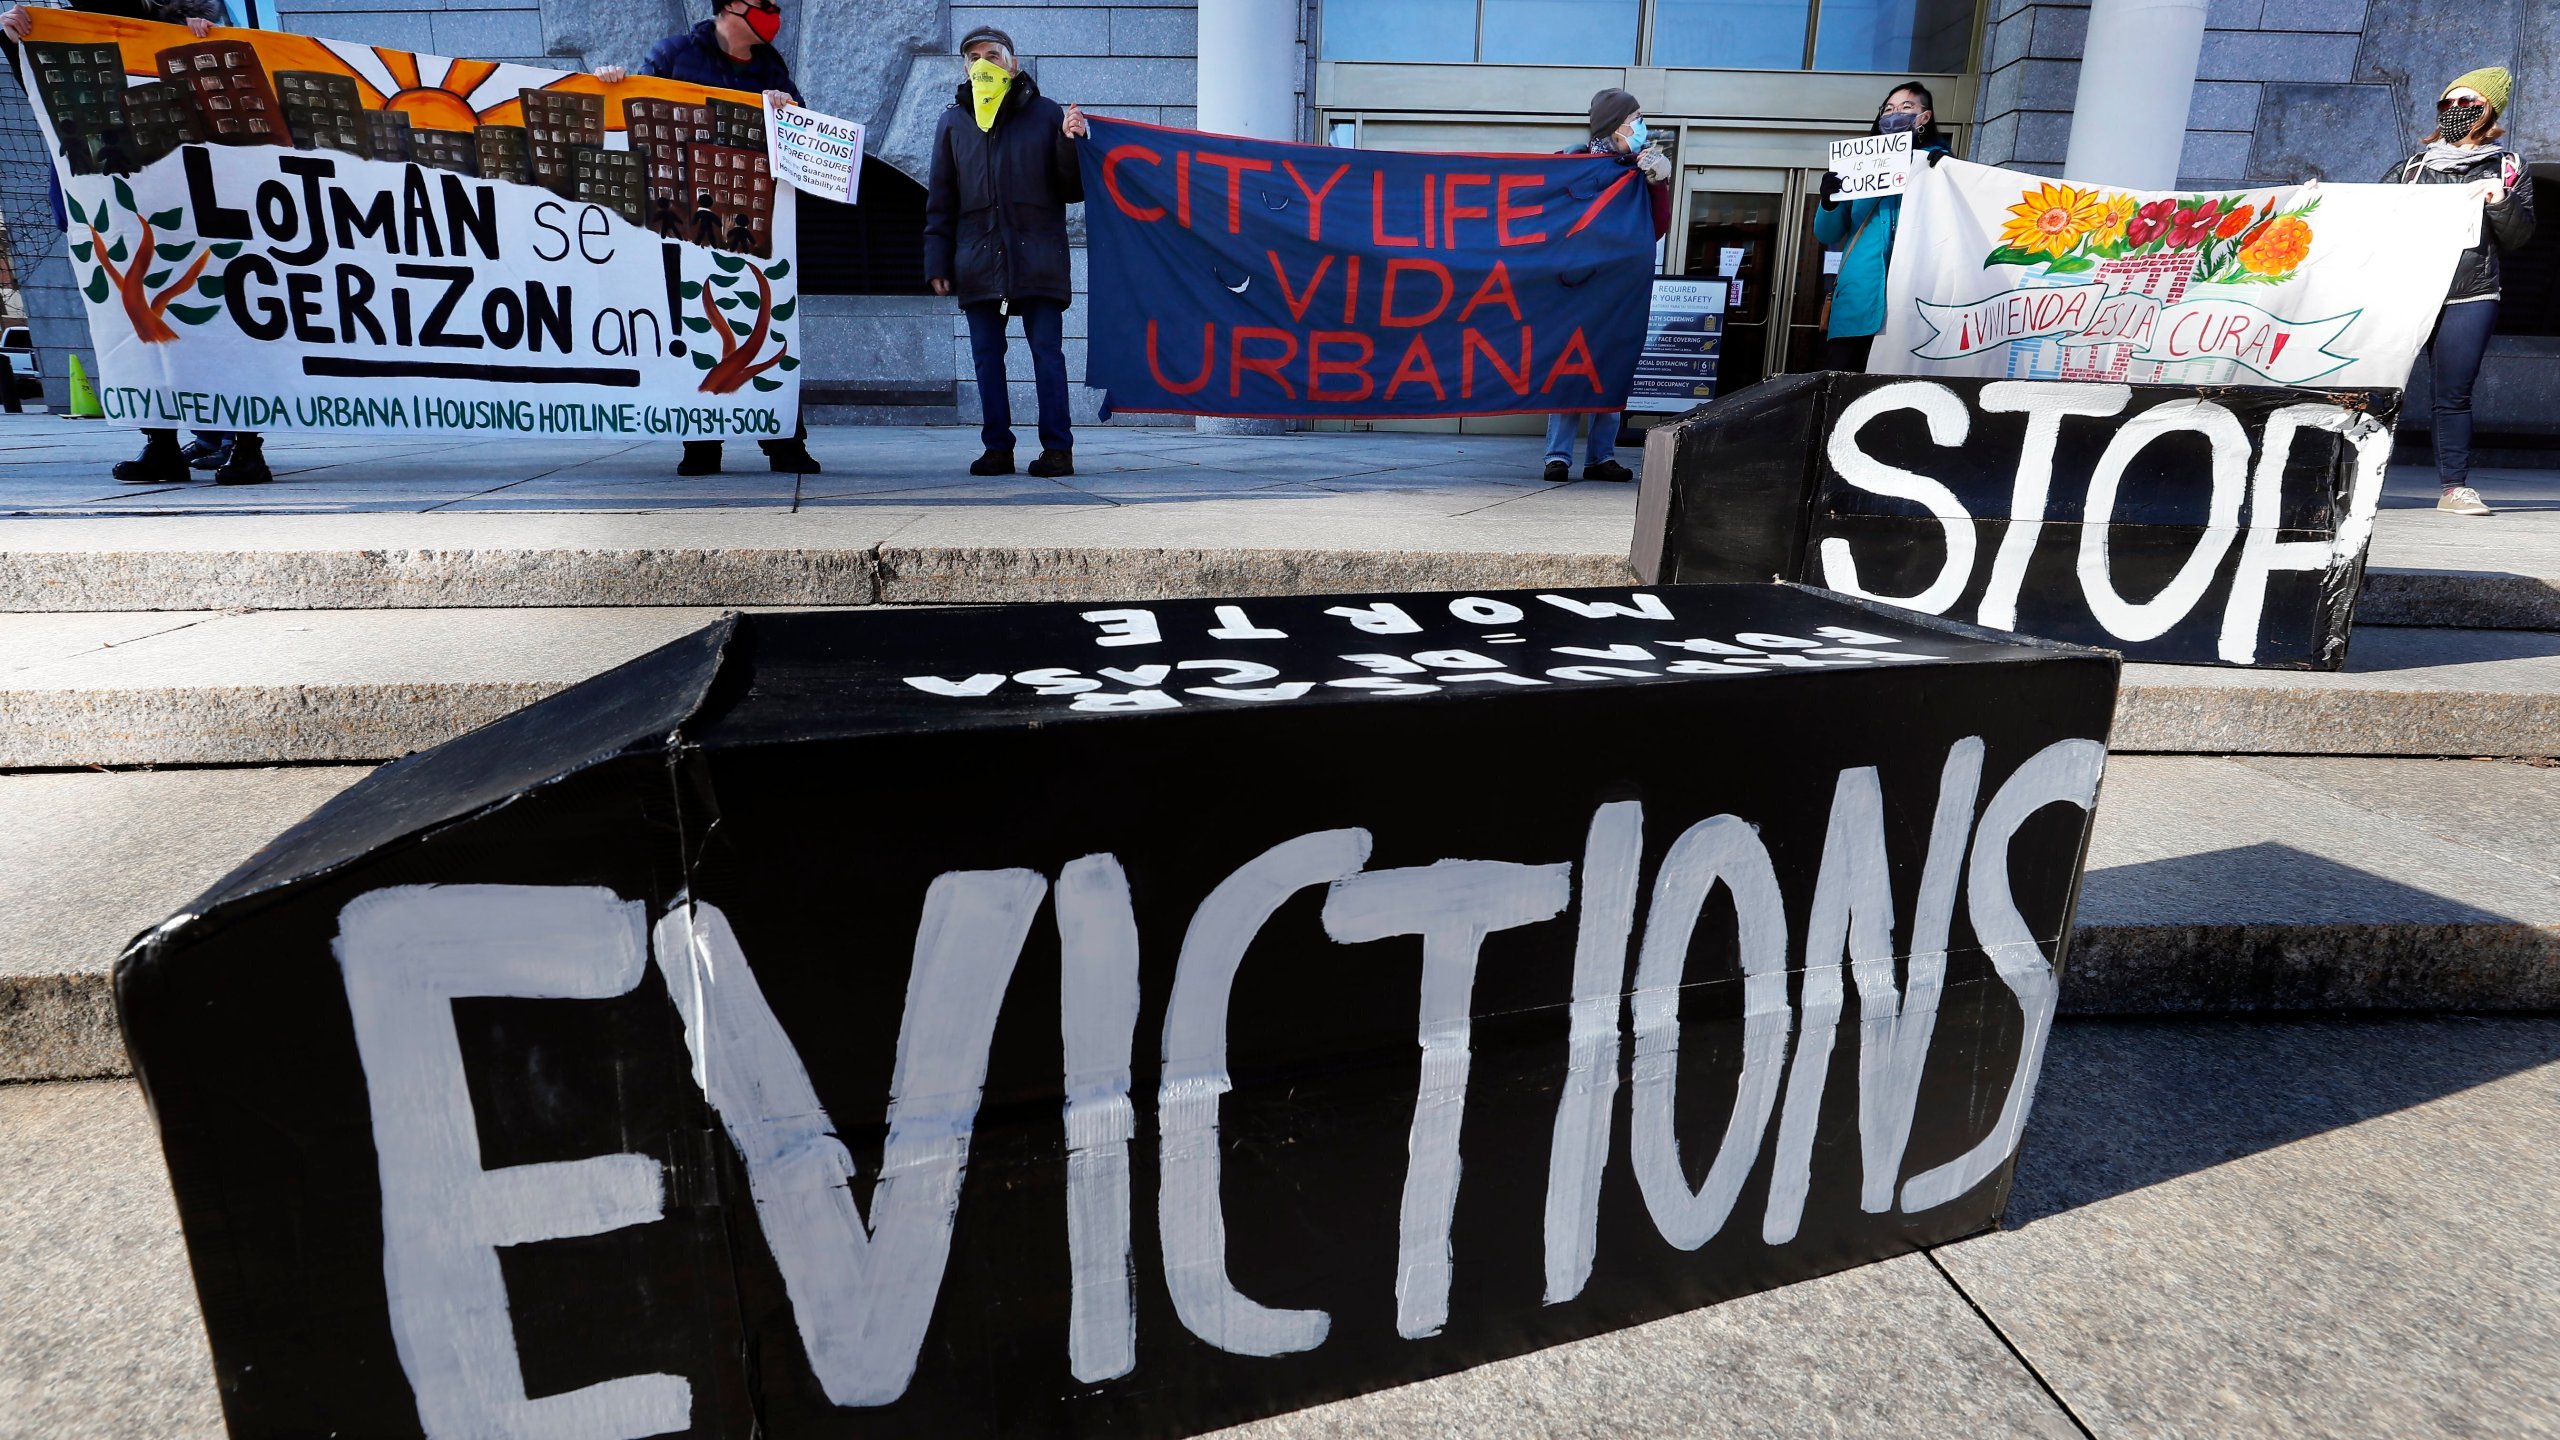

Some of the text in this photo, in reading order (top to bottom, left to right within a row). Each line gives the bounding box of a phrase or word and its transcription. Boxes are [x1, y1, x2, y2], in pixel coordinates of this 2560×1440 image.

[776, 109, 856, 142] STOP MASS
[777, 127, 853, 159] EVICTIONS!
[778, 142, 782, 150] &
[784, 145, 853, 174] FORECLOSURES
[1832, 134, 1907, 160] HOUSING
[801, 165, 847, 183] Guaranteed
[1853, 157, 1890, 170] IS THE
[802, 175, 834, 190] Stability
[835, 185, 849, 194] Act
[1102, 145, 1349, 240] CITY
[1374, 171, 1545, 248] LIFE
[1841, 172, 1890, 193] CURE
[182, 146, 615, 266] LOJMAN se
[223, 243, 688, 358] GERIZON an!
[1267, 250, 1522, 328] VIDA
[1659, 285, 1697, 294] REQUIRED
[1661, 295, 1681, 303] YOUR
[2169, 311, 2290, 371] CURA!
[1147, 320, 1603, 401] URBANA
[1701, 361, 1707, 370] 6
[104, 387, 151, 419] CITY
[296, 396, 409, 428] URBANA
[426, 398, 535, 432] HOUSING
[539, 402, 641, 433] HOTLINE:
[644, 407, 781, 435] (617)934-5006
[1821, 381, 2392, 665] STOP
[1081, 593, 1675, 647] MORTE
[903, 658, 1280, 697] CASA
[1338, 650, 1508, 675] DE
[332, 736, 2107, 1440] EVICTIONS
